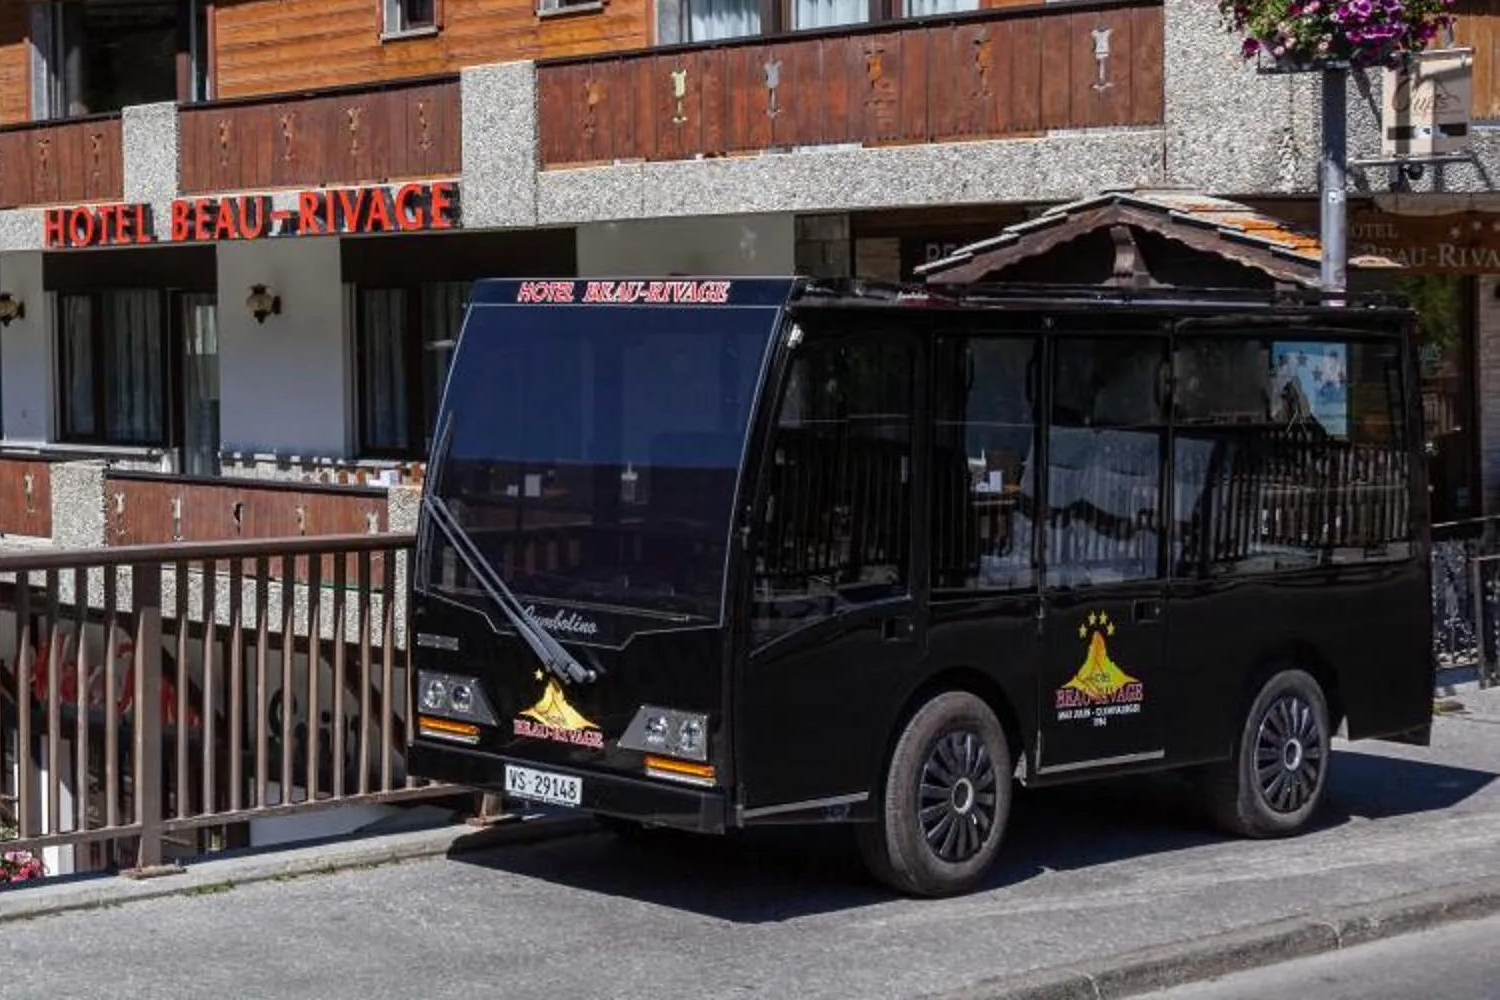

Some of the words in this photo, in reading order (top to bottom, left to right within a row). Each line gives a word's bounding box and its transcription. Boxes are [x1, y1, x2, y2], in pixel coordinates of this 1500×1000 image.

[44, 203, 155, 249] HOTEL
[170, 182, 457, 241] BEAU-RIVAGE
[1350, 222, 1399, 239] OTEL
[517, 281, 575, 303] HOTEL
[582, 281, 731, 304] BEAU-RIVAGE
